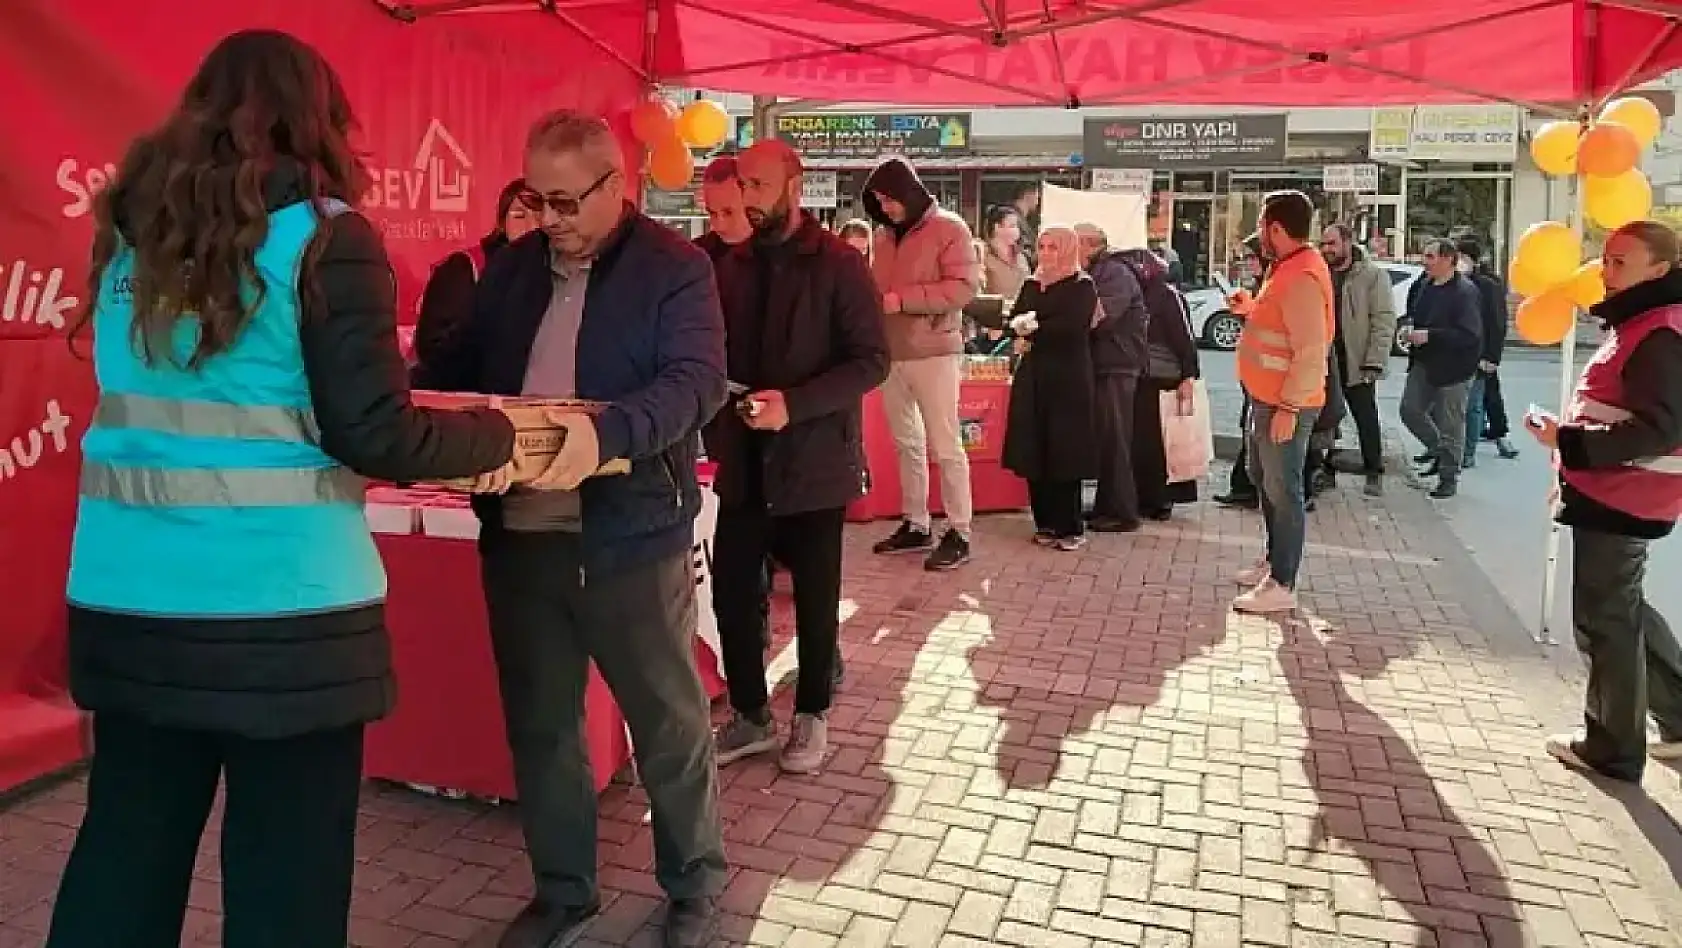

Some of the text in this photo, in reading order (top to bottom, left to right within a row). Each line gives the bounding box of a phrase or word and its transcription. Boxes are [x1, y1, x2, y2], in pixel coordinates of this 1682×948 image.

[1142, 122, 1187, 139] DNR
[1192, 120, 1237, 138] YAPI
[361, 168, 424, 210] SEV
[0, 259, 80, 329] lik
